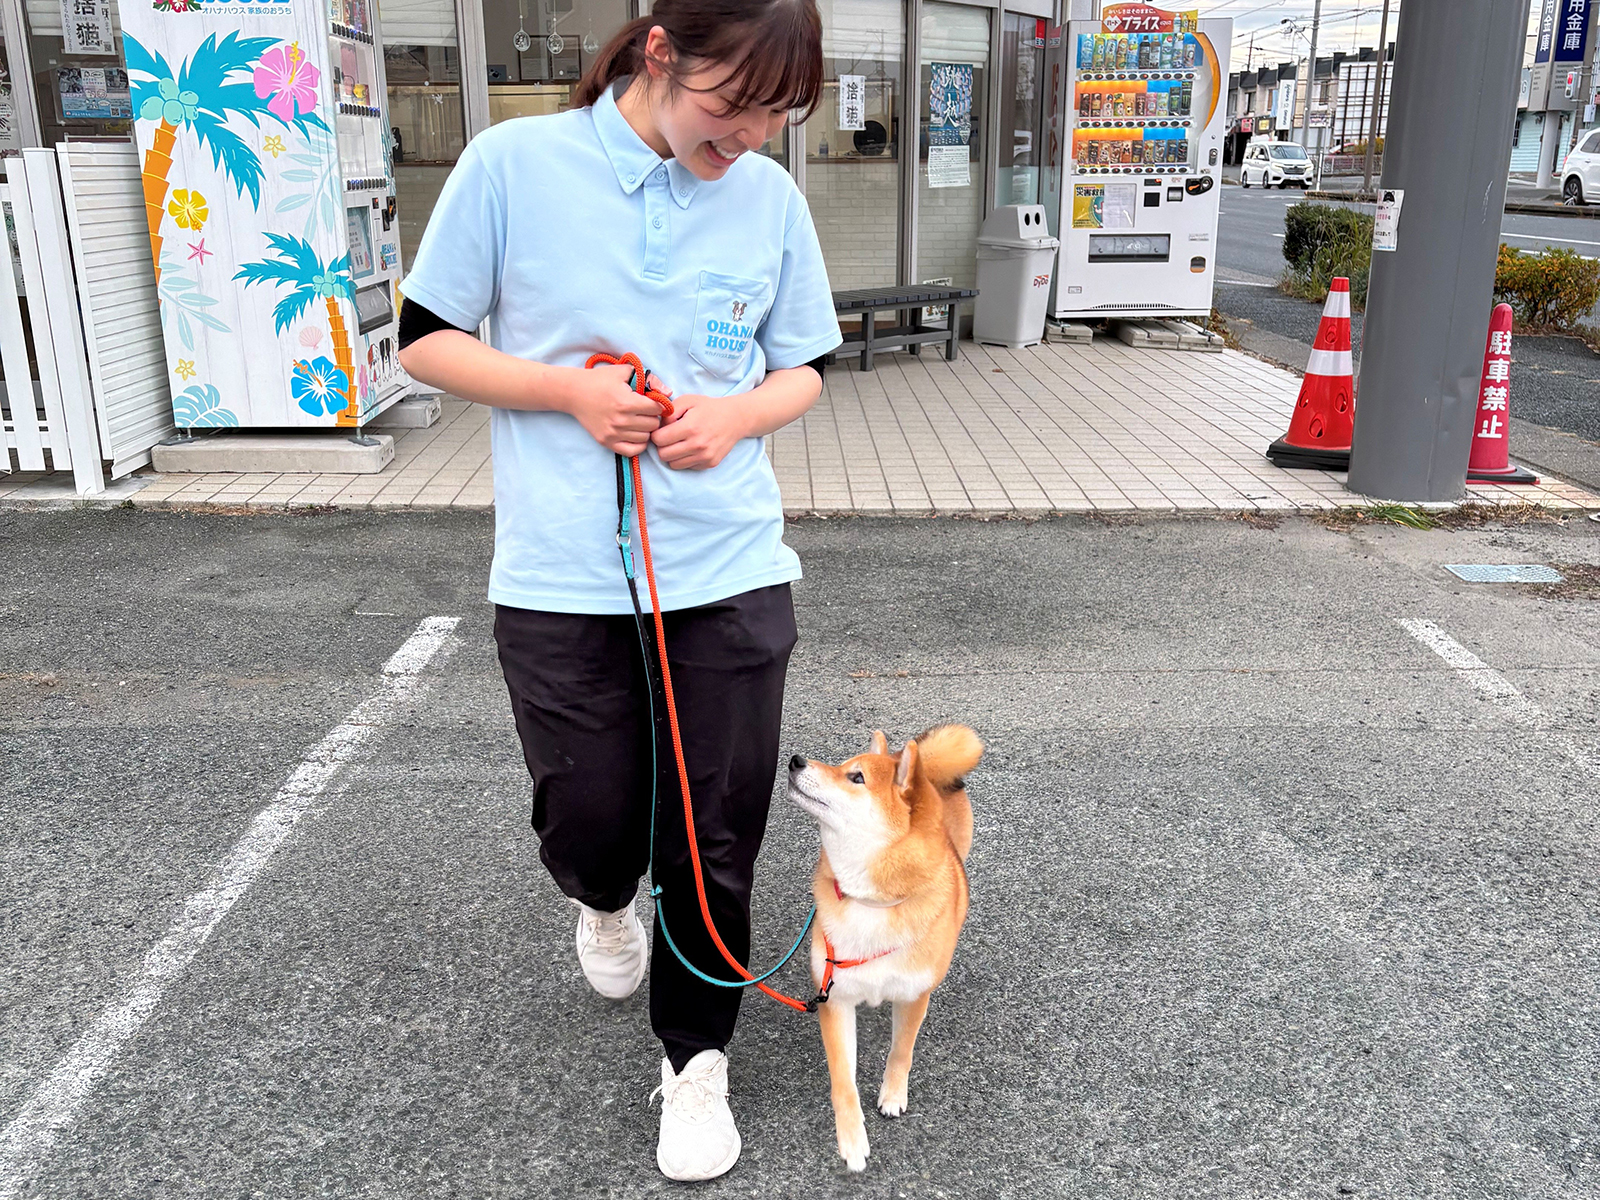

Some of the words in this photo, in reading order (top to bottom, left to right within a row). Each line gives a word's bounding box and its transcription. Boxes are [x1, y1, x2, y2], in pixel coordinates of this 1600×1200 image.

[202, 7, 246, 15] オハナハウス
[247, 7, 292, 15] 家族のおうち
[1122, 16, 1160, 31] プライス
[1563, 0, 1586, 51] 用金庫
[1033, 277, 1049, 288] DyDo
[1477, 330, 1512, 439] 駐車禁止
